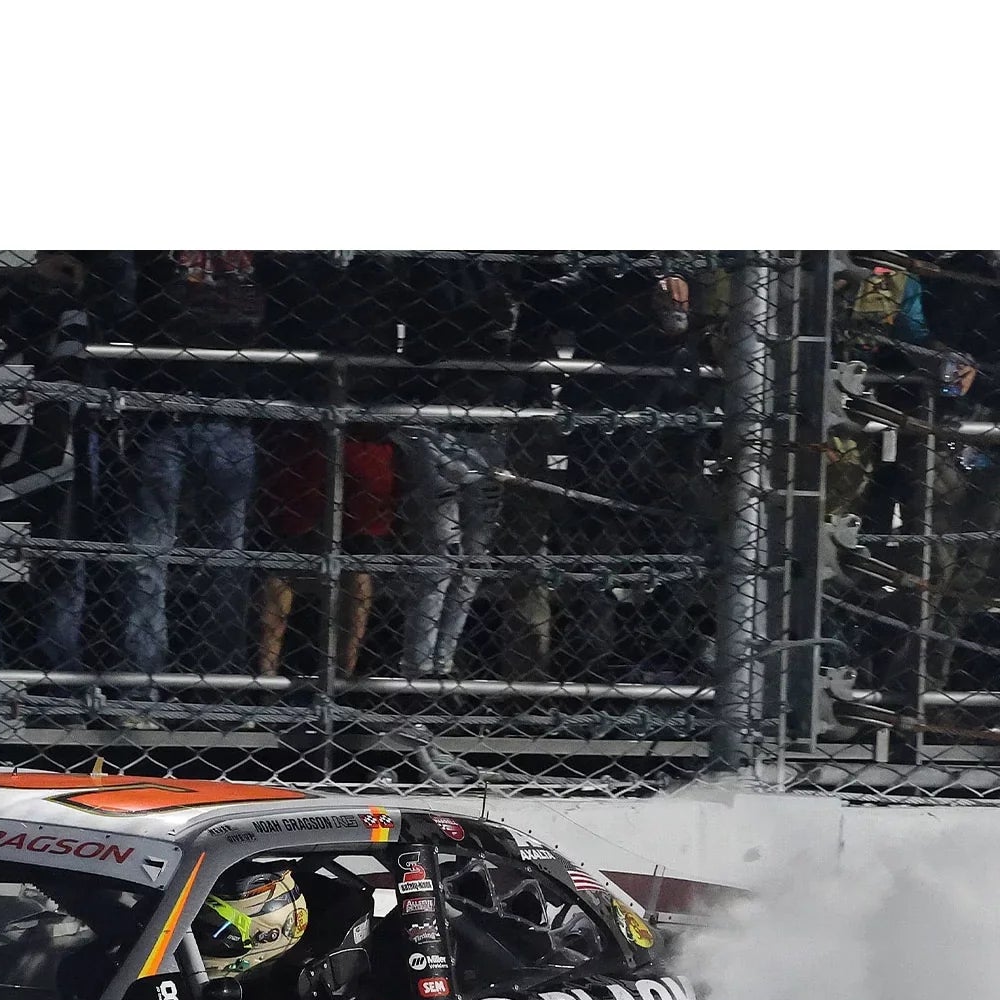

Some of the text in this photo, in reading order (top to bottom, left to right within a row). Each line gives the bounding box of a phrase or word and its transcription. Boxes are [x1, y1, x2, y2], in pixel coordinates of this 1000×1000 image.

[252, 820, 282, 833] NOAH
[281, 815, 333, 832] GRAGSON
[520, 849, 556, 861] AXALTA
[423, 980, 446, 994] SEM
